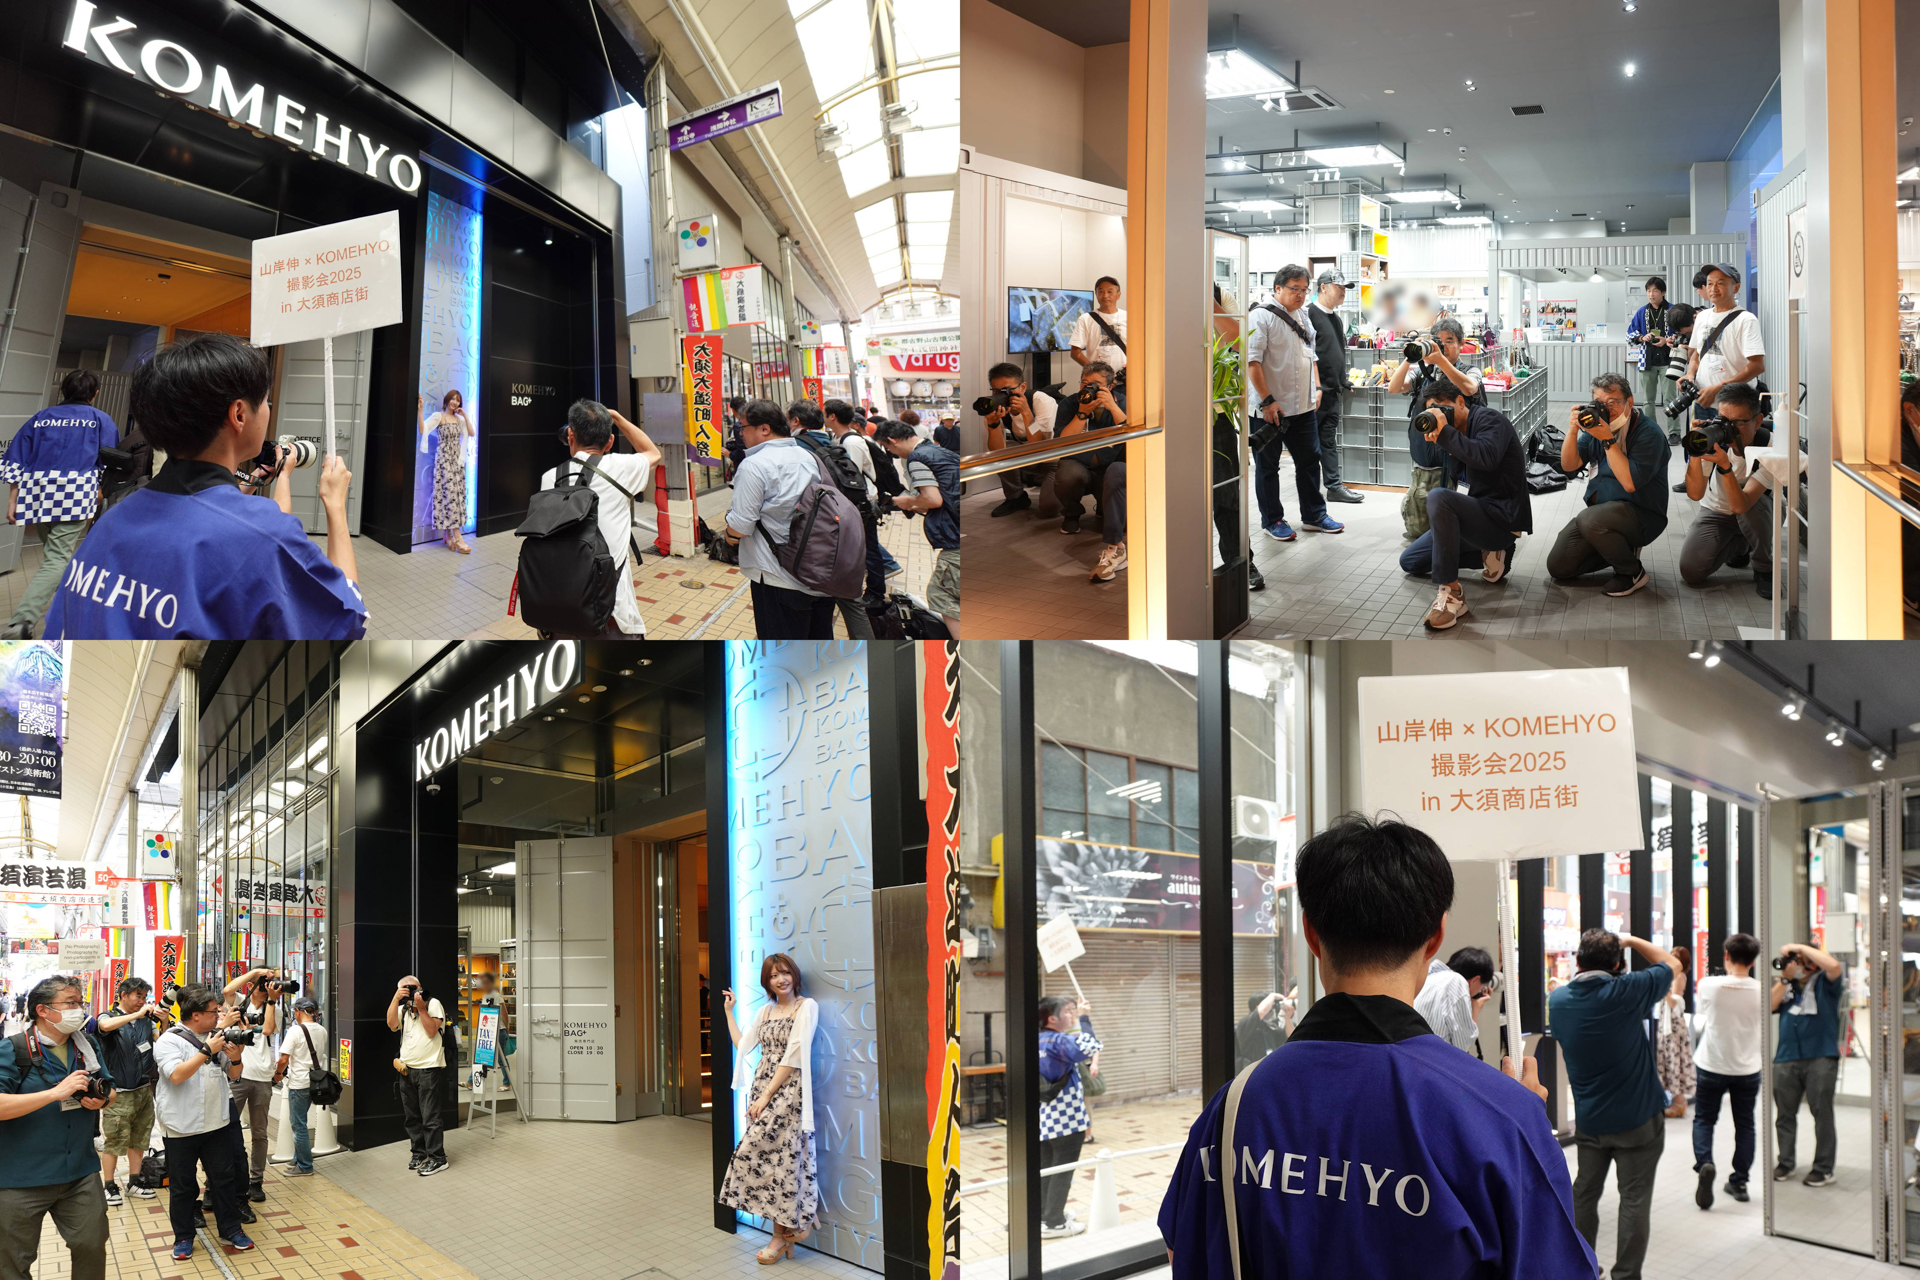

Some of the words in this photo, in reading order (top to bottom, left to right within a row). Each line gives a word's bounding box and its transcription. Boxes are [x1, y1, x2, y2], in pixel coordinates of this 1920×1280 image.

[63, 0, 421, 192] KOMEHYO
[260, 256, 299, 277] 山岸伸
[316, 239, 390, 265] KOMEHYO
[287, 266, 362, 293] 撮影会2025
[281, 302, 292, 313] in
[297, 286, 369, 313] 大須商店街
[511, 383, 556, 396] KOMEHYO
[416, 640, 576, 782] KOMEHYO
[1378, 718, 1453, 743] 山岸伸
[1485, 713, 1617, 738] KOMEHYO
[1431, 751, 1567, 777] 撮影会2025
[1421, 792, 1441, 811] in
[1450, 784, 1579, 812] 大須商店街
[478, 1039, 493, 1050] FREE
[480, 1029, 490, 1039] TAX
